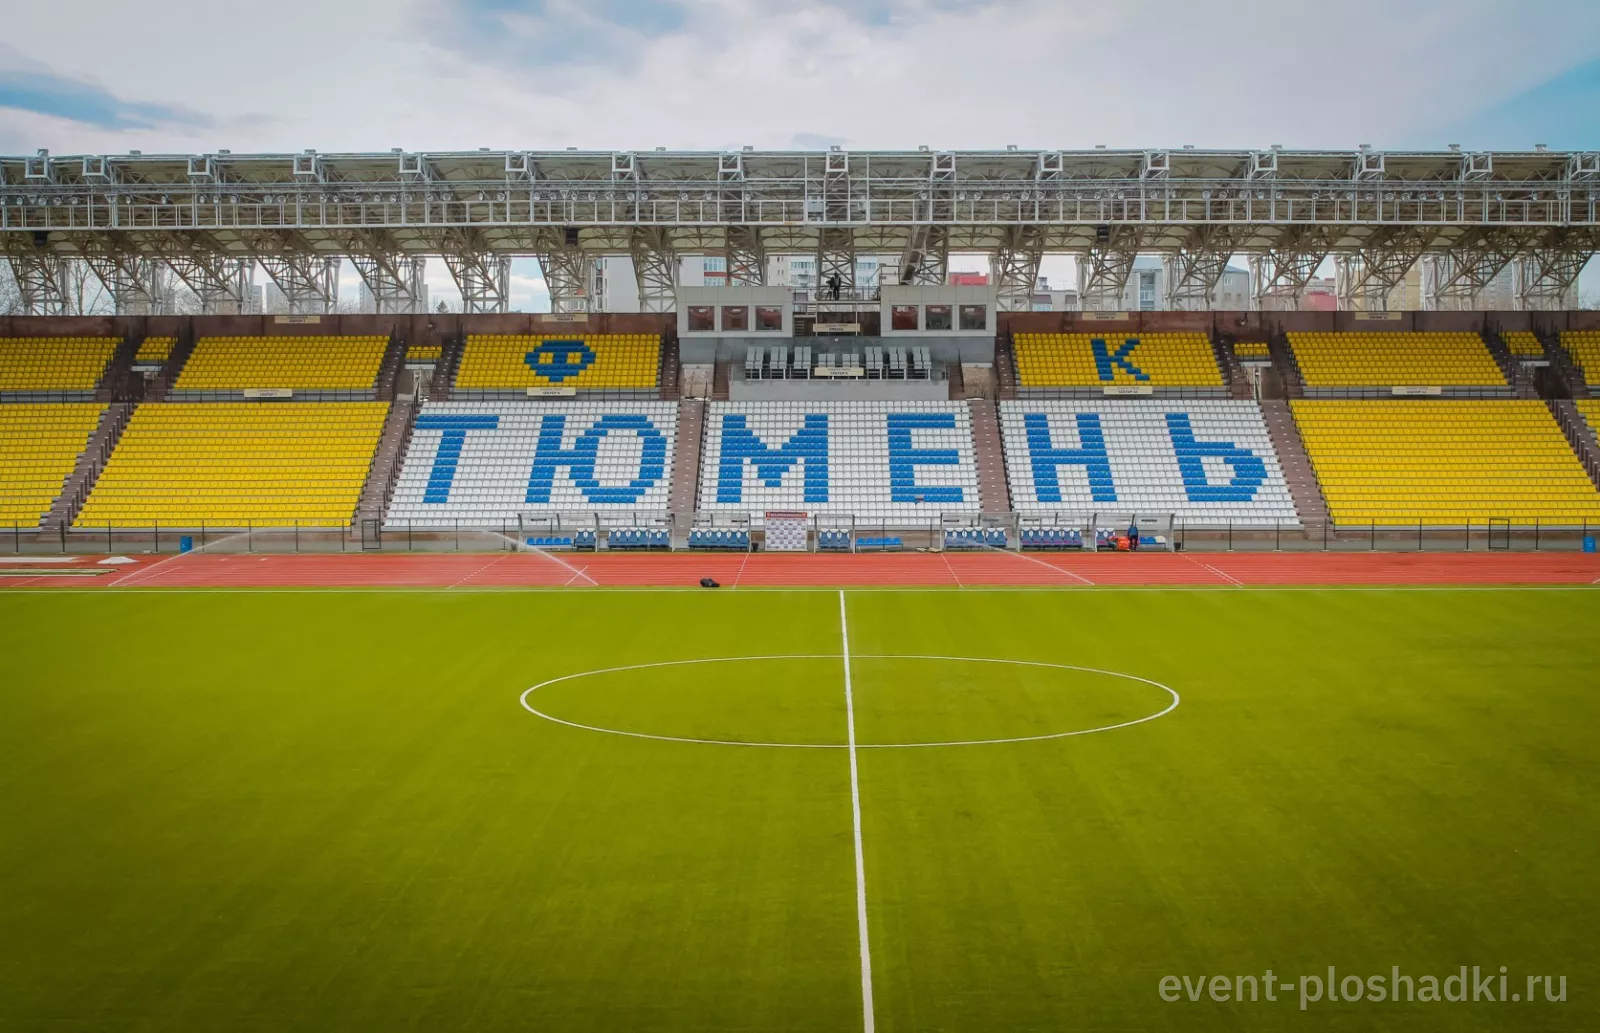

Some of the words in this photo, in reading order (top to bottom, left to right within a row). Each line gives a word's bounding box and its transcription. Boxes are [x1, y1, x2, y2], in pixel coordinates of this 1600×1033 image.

[524, 340, 596, 382] Ф
[1090, 339, 1149, 381] К
[413, 412, 1268, 503] ТЮМЕНЬ
